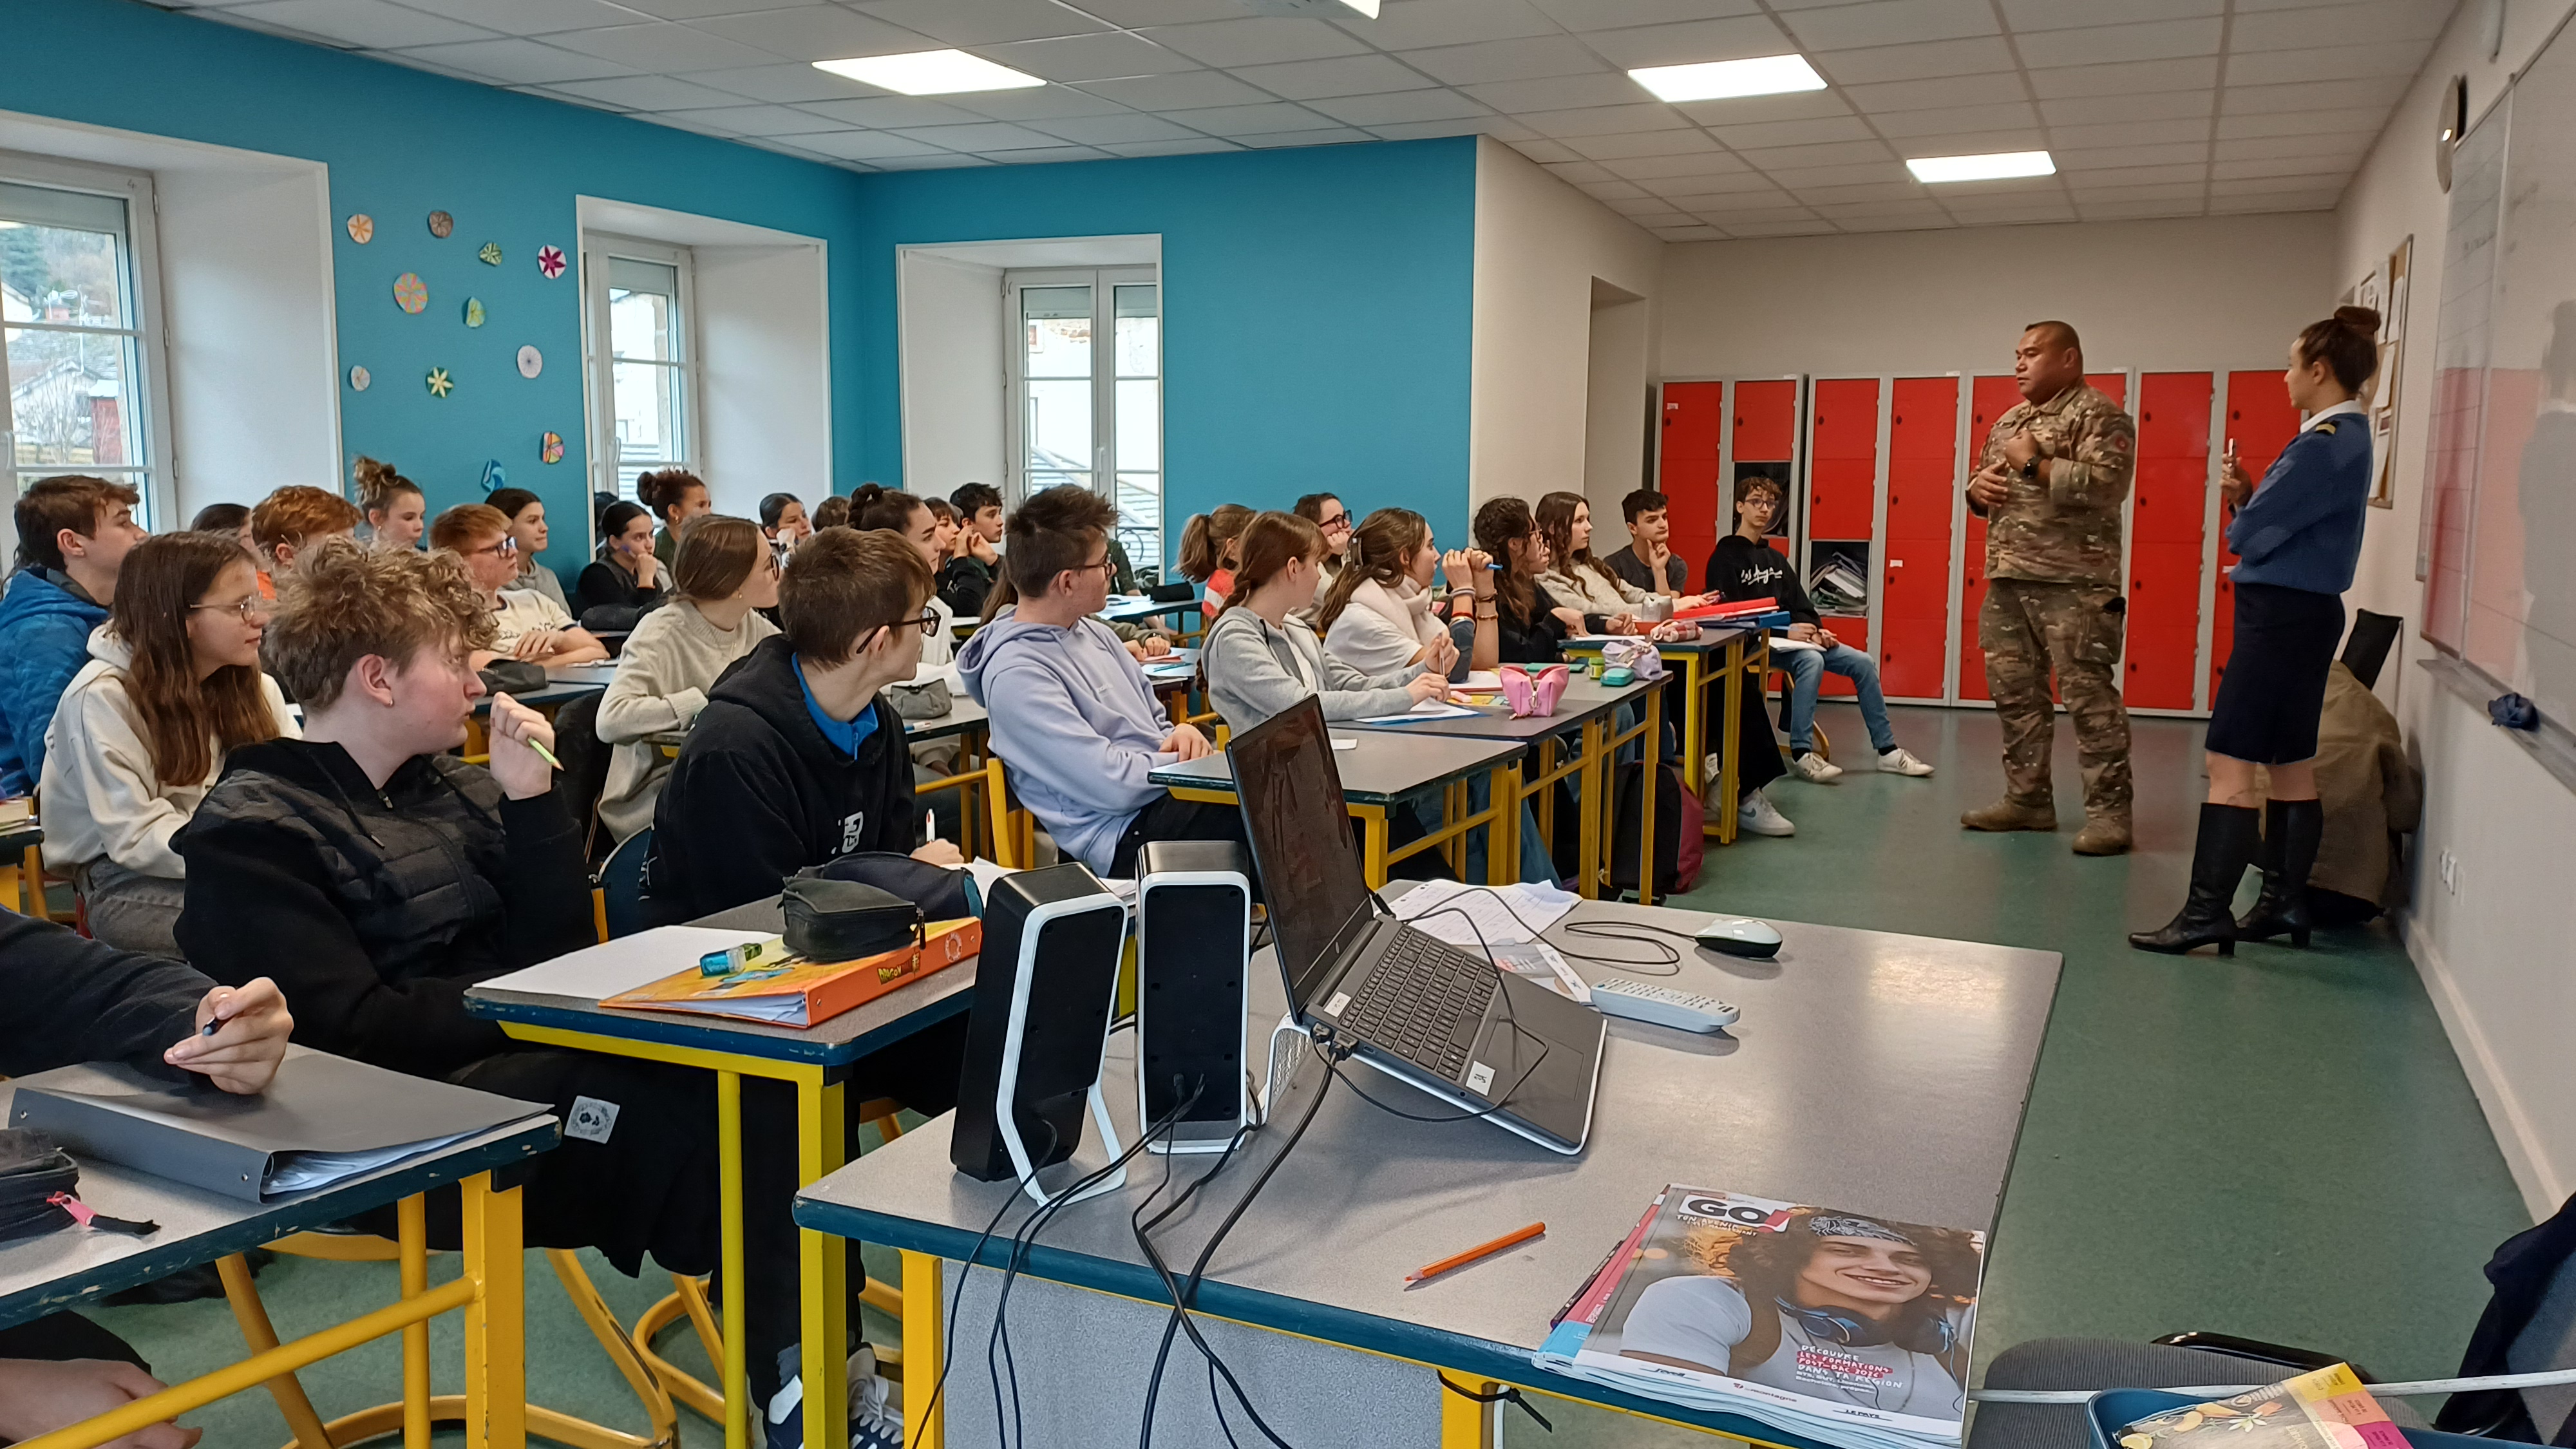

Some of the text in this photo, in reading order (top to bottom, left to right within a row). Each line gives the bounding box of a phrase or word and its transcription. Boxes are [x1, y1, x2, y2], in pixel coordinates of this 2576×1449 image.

[1676, 1215, 1698, 1224] TON
[1687, 1198, 1793, 1234] GO!
[1801, 1345, 1860, 1361] DÉCOUVRE
[1799, 1358, 1850, 1374] POST-BAC
[1800, 1351, 1890, 1374] LES FORMATIONS
[1797, 1364, 1829, 1376] DANS
[1835, 1372, 1850, 1381] TA
[1750, 1388, 1797, 1402] montagne
